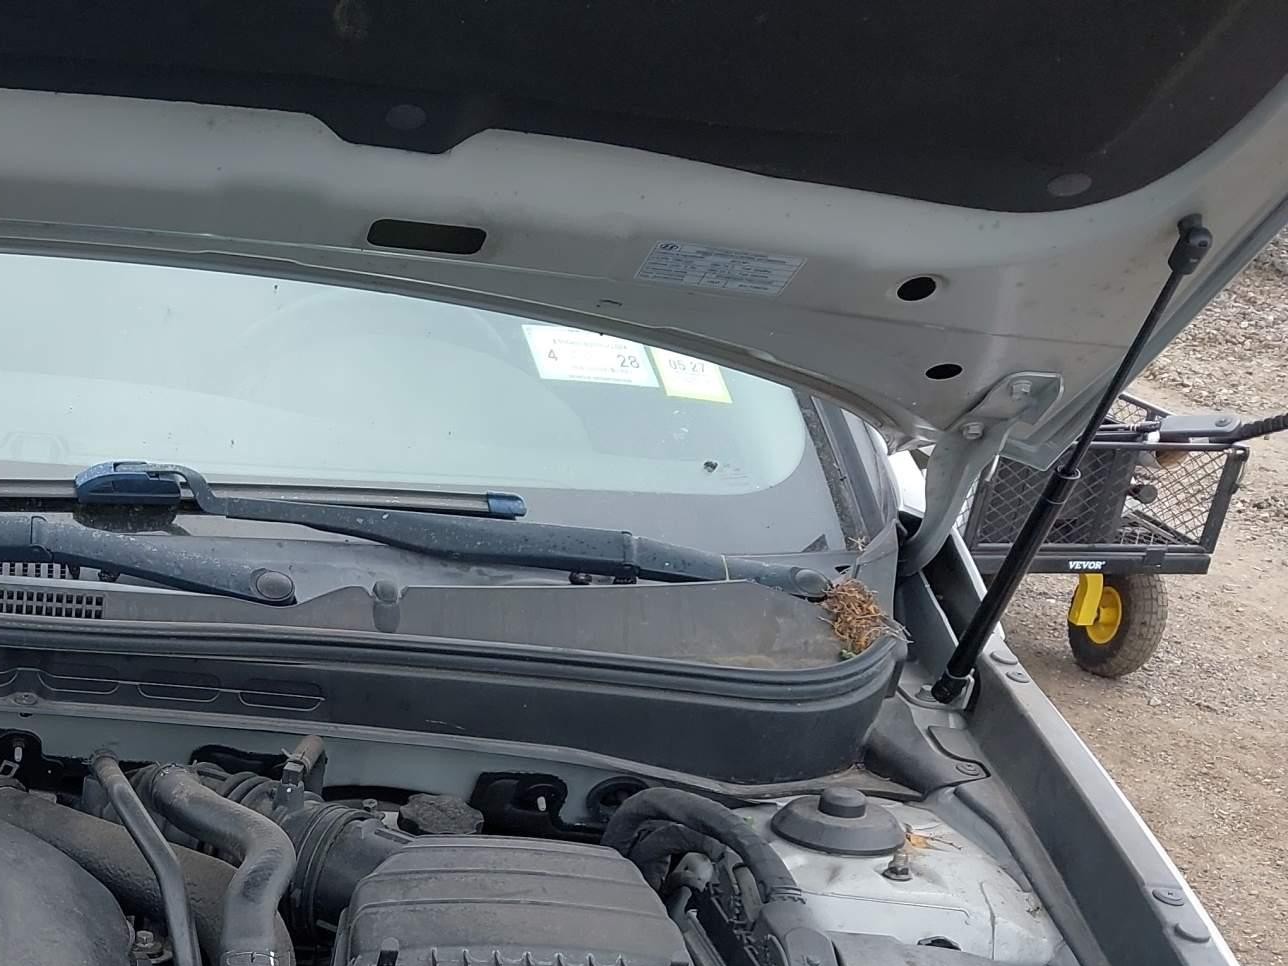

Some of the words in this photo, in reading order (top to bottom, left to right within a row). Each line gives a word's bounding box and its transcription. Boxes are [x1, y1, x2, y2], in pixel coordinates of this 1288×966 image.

[547, 349, 558, 361] 4
[616, 353, 640, 369] 28
[1068, 561, 1103, 570] VEVOR
